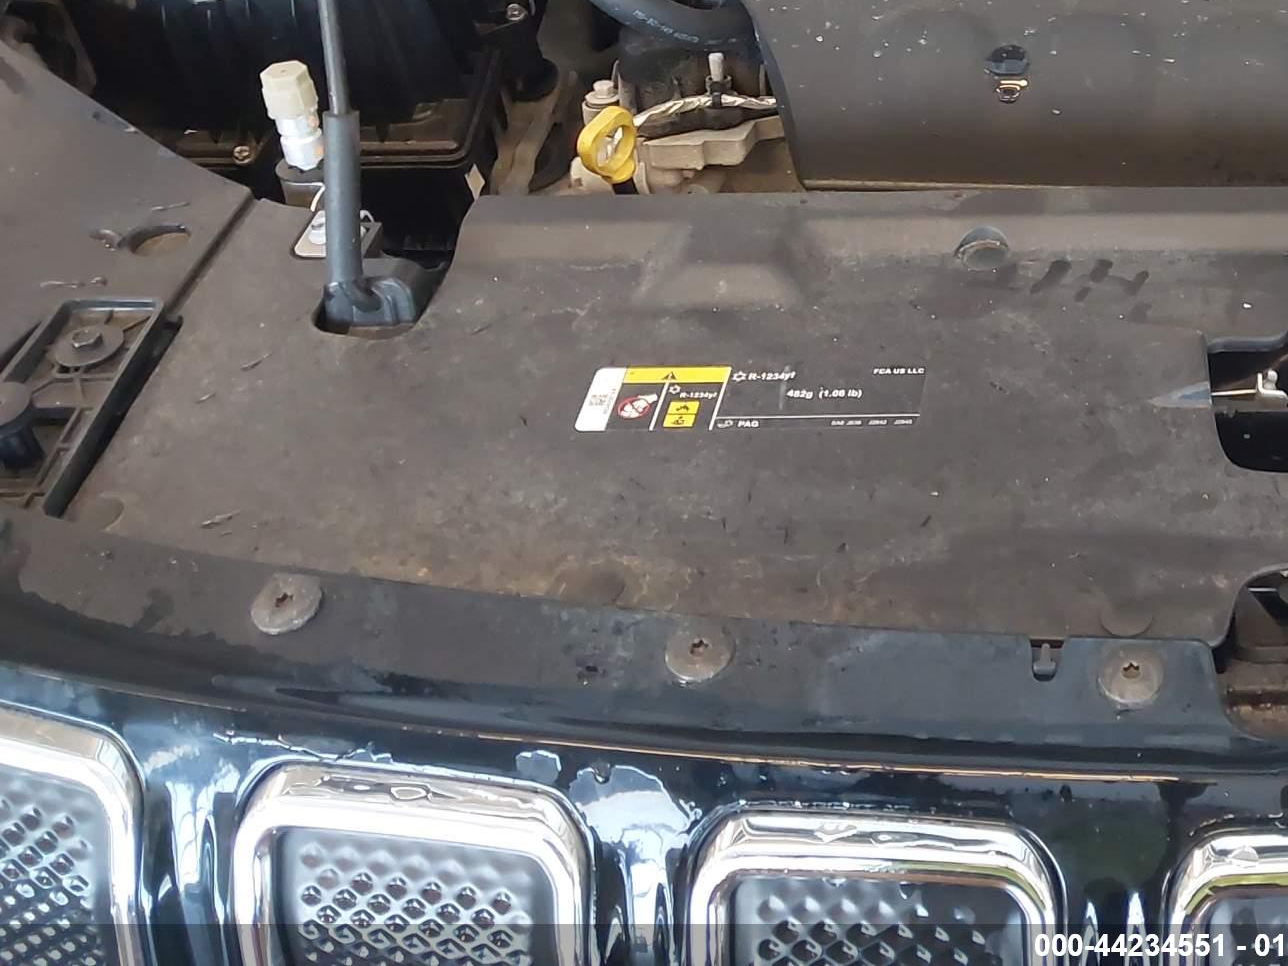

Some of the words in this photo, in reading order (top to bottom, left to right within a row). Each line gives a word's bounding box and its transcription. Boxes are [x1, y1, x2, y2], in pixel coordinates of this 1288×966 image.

[748, 371, 796, 382] R-1234yf
[786, 389, 813, 399] 482g
[847, 388, 863, 399] lb)
[737, 420, 759, 428] PAG
